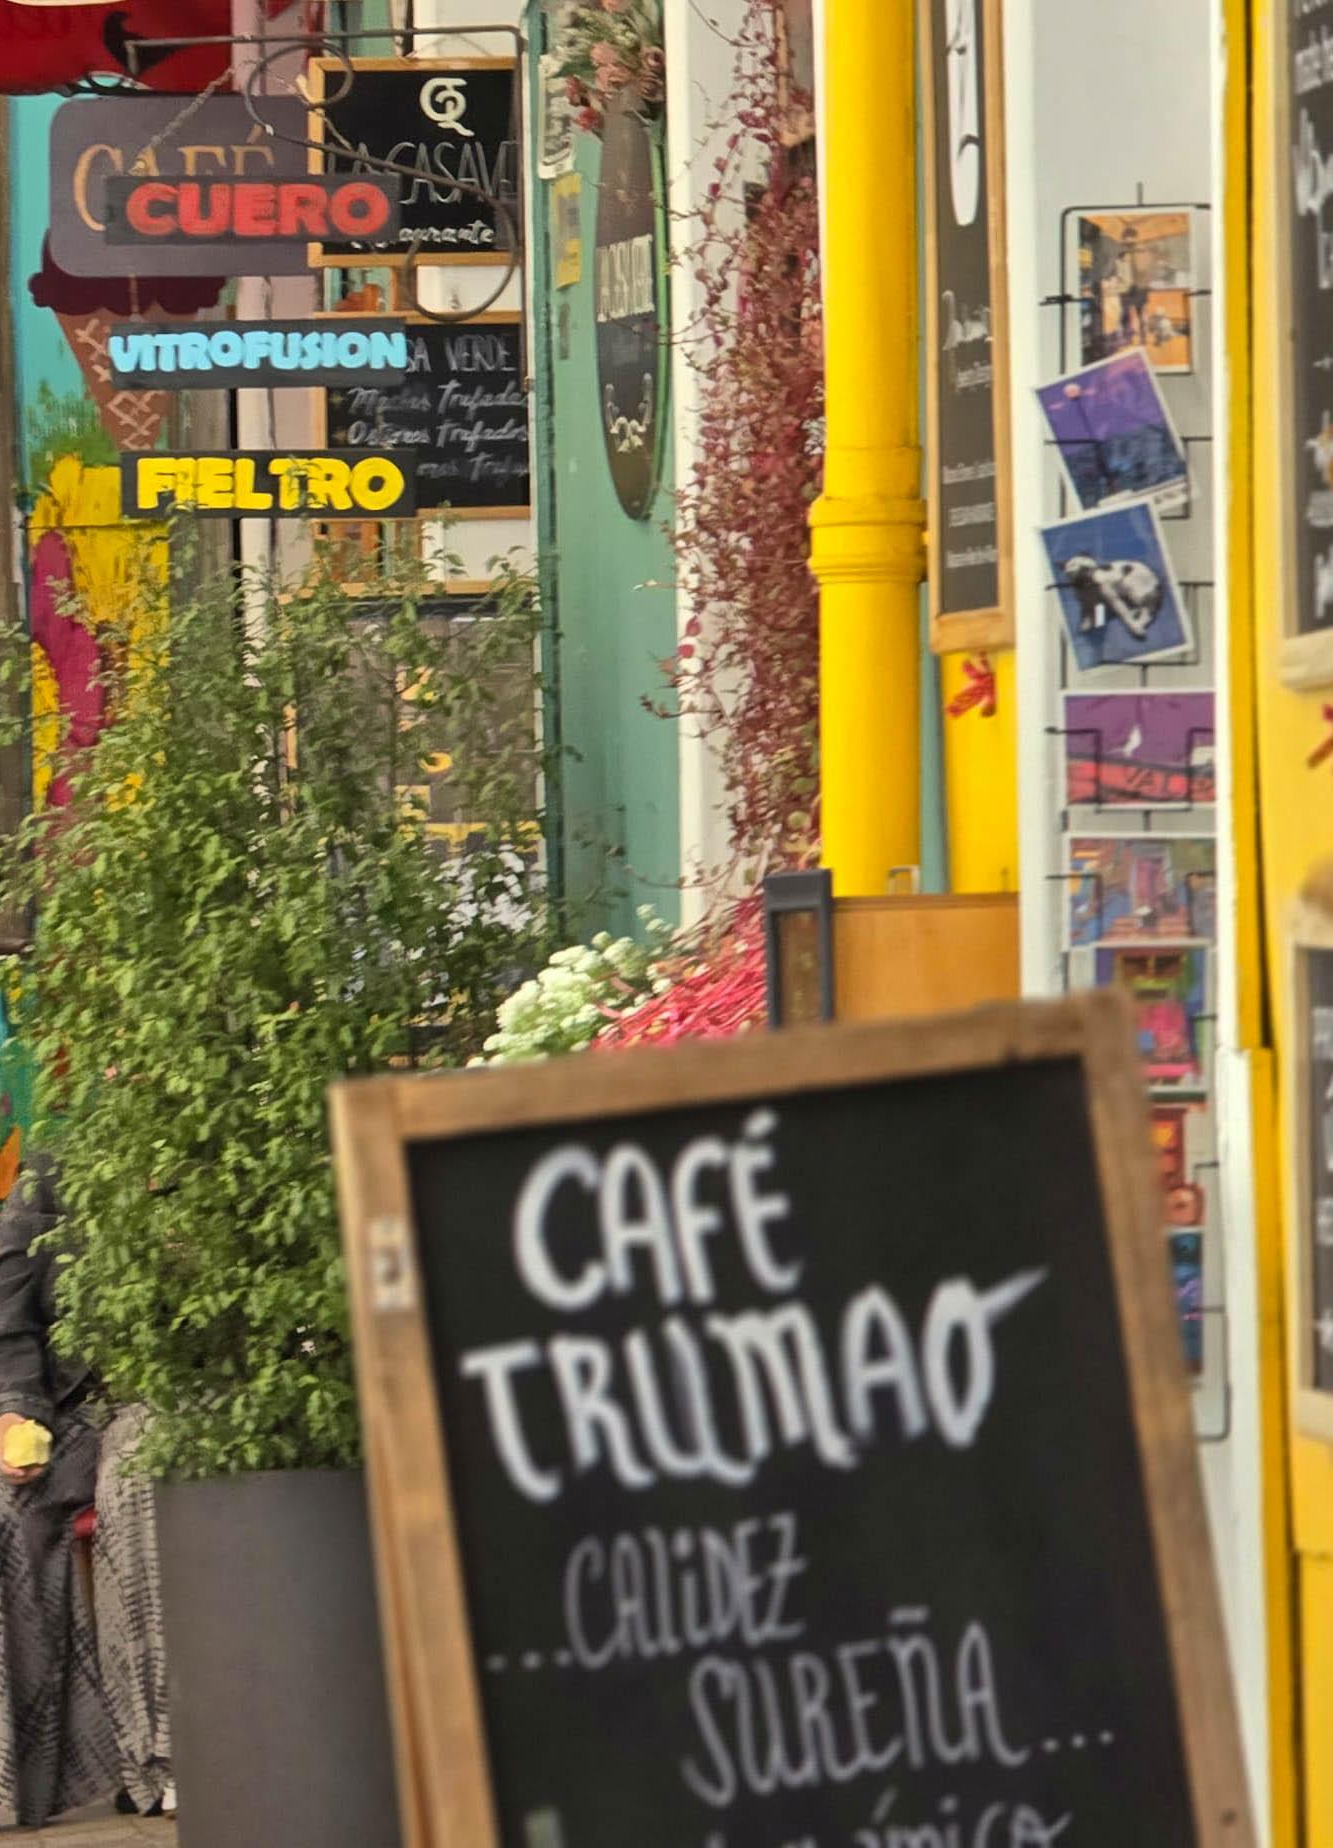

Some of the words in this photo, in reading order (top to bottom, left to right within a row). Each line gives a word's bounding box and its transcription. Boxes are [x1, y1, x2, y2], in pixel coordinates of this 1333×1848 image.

[126, 182, 389, 236] CUERO
[108, 331, 407, 373] VITROFUSION
[137, 457, 405, 511] FIELTRO
[515, 1110, 805, 1309] CAFÉ
[459, 1266, 1049, 1502] TRUMAO
